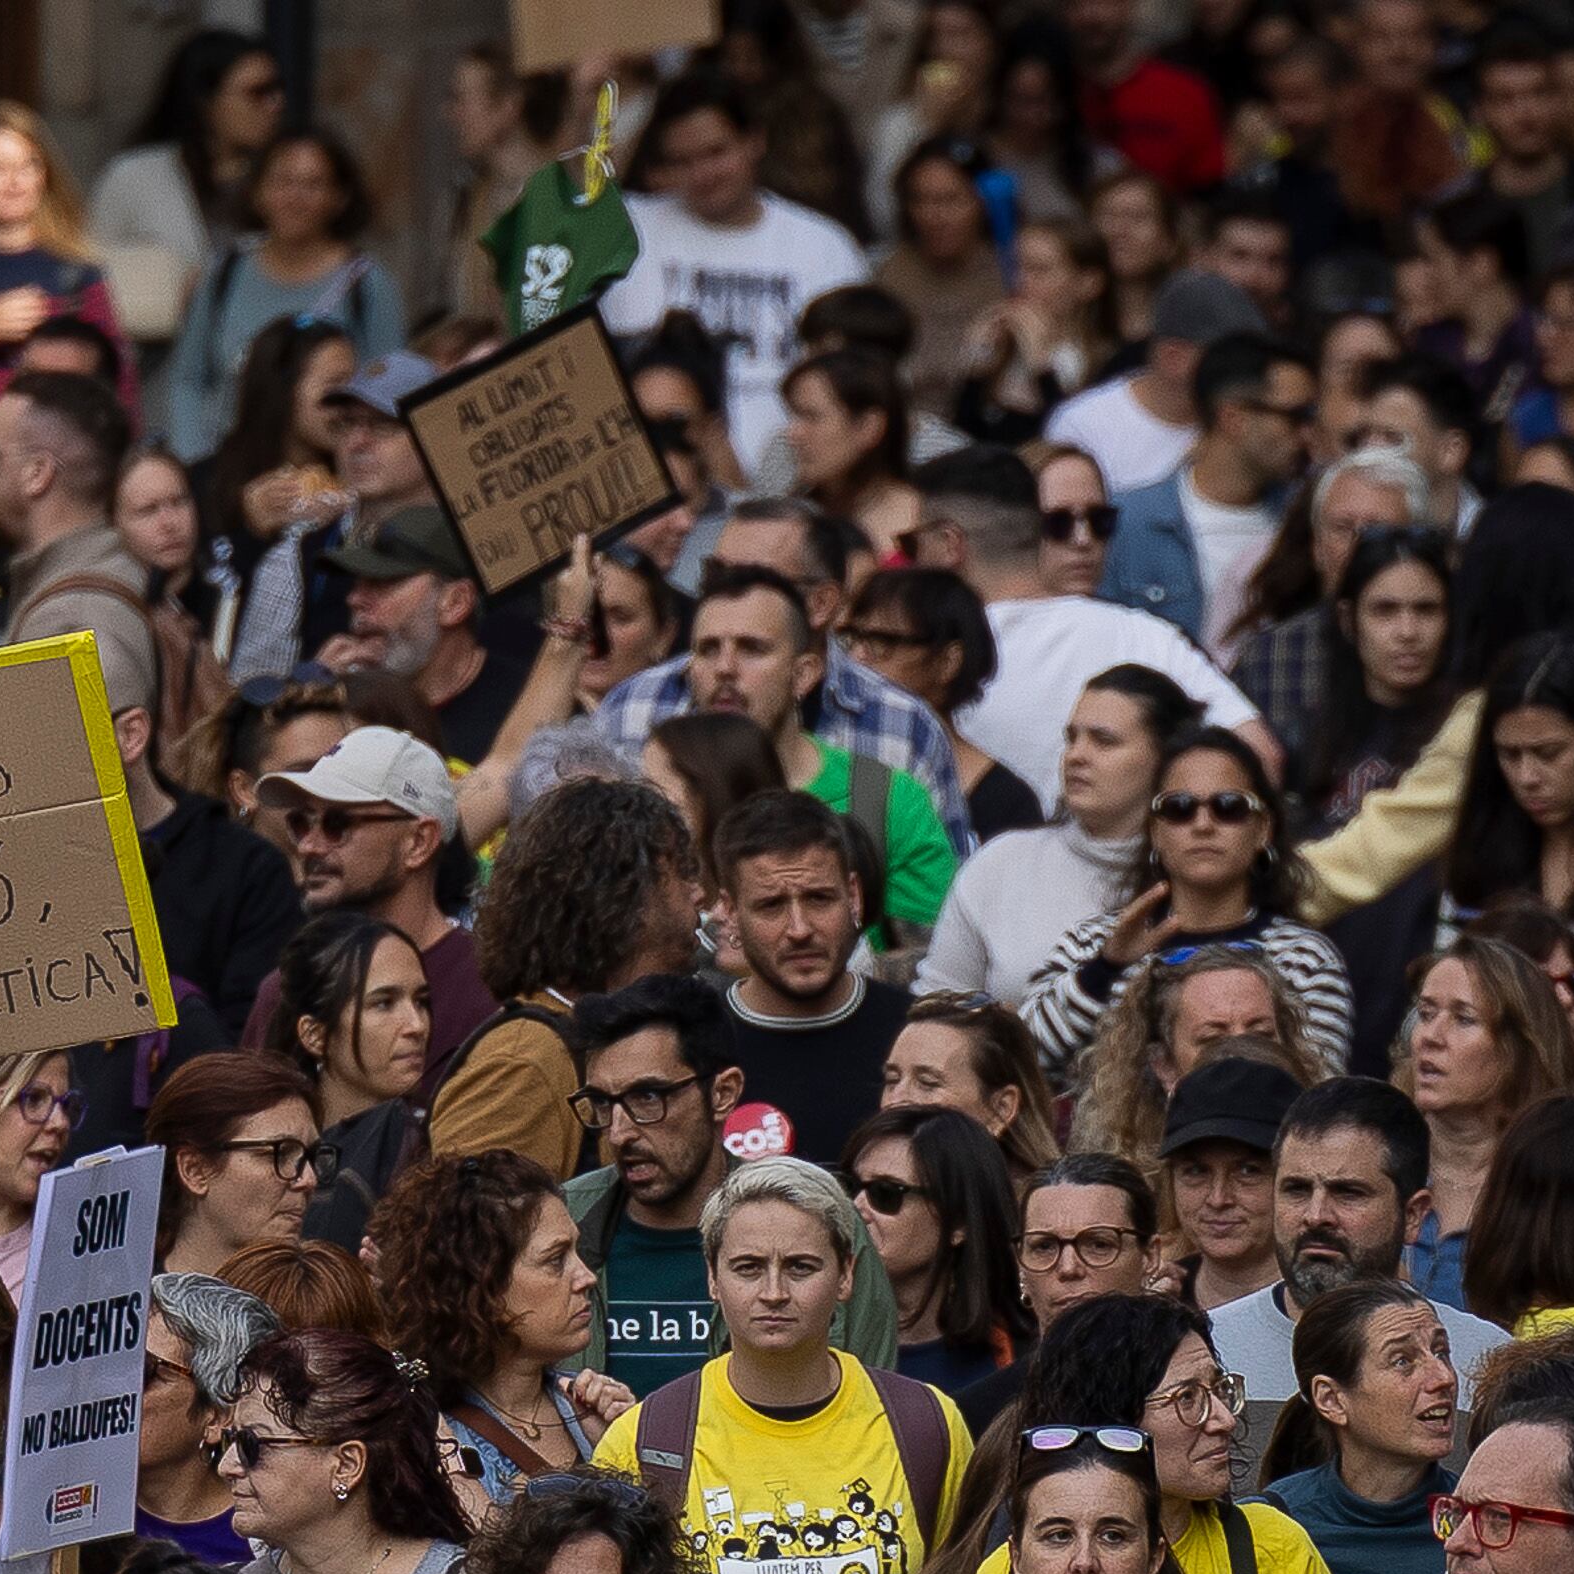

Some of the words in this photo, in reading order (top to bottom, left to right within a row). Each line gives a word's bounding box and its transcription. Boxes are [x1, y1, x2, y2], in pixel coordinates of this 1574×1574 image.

[72, 1190, 131, 1259] SOM
[32, 1291, 144, 1371] DOCENTS
[649, 1311, 681, 1341] la
[20, 1412, 47, 1457] NO
[48, 1392, 138, 1451] BALDUFES!
